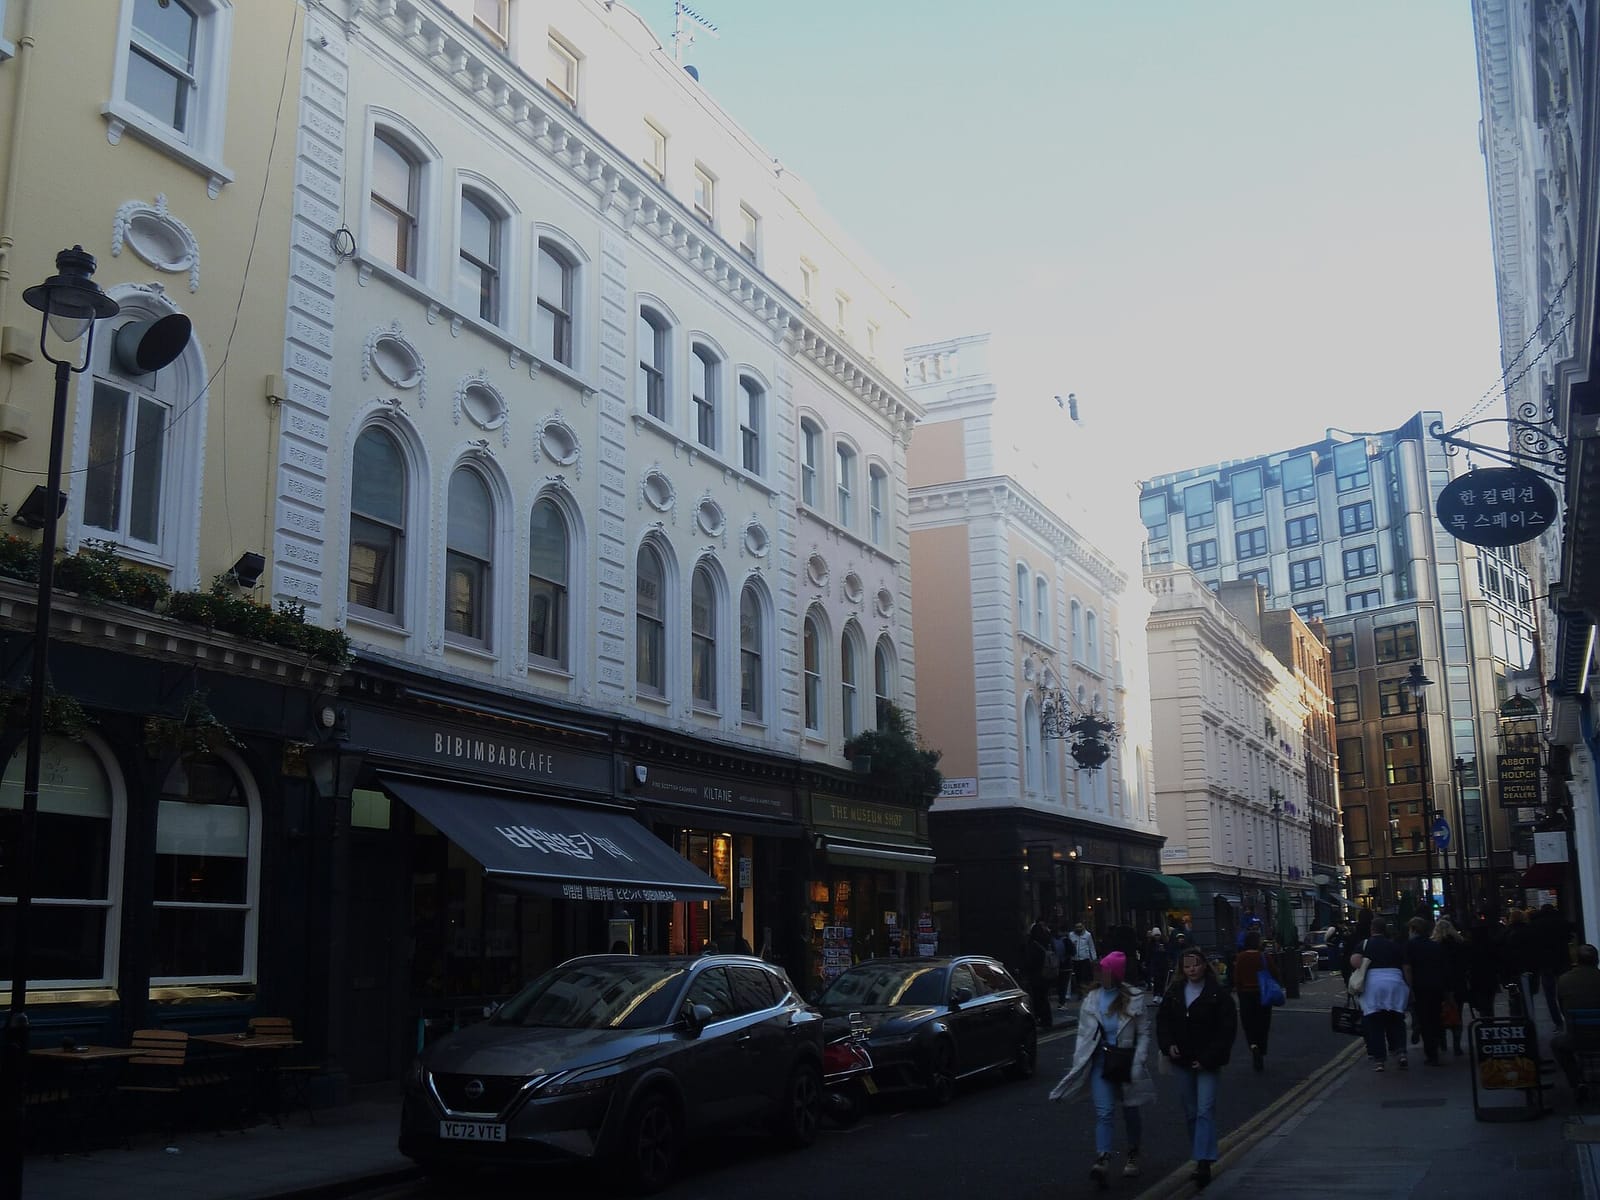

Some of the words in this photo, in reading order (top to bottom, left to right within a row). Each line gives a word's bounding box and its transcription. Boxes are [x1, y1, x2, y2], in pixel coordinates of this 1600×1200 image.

[1458, 489, 1476, 506] 한
[1451, 514, 1468, 531] 목
[1473, 510, 1545, 529] 스페이스
[1501, 758, 1536, 766] ABBOTT
[704, 787, 733, 803] KILTANE
[830, 804, 848, 819] THE
[850, 808, 883, 824] MUSEUM
[884, 812, 904, 826] SHOP
[1480, 1027, 1526, 1040] FISH
[1482, 1044, 1526, 1054] CHIPS
[446, 1124, 475, 1137] YC72
[479, 1126, 501, 1139] VTE
